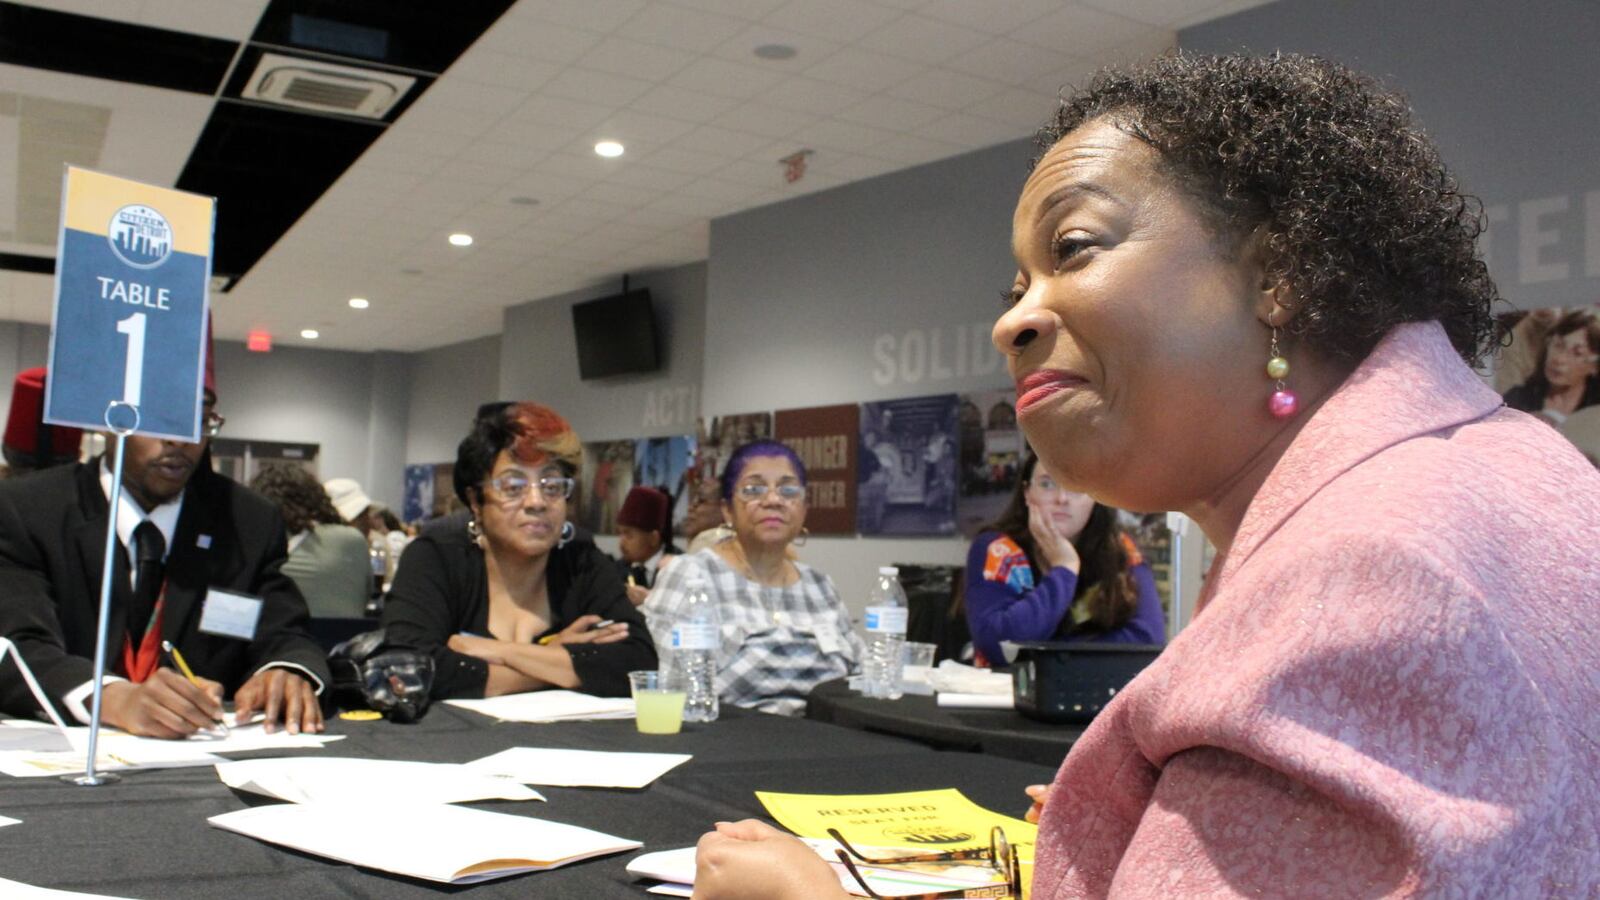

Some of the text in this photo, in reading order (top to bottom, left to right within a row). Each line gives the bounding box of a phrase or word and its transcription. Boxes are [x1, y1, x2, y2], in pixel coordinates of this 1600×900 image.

[97, 276, 170, 310] TABLE
[117, 312, 147, 407] 1
[872, 323, 1006, 386] SOLID
[817, 805, 937, 817] RESERVED
